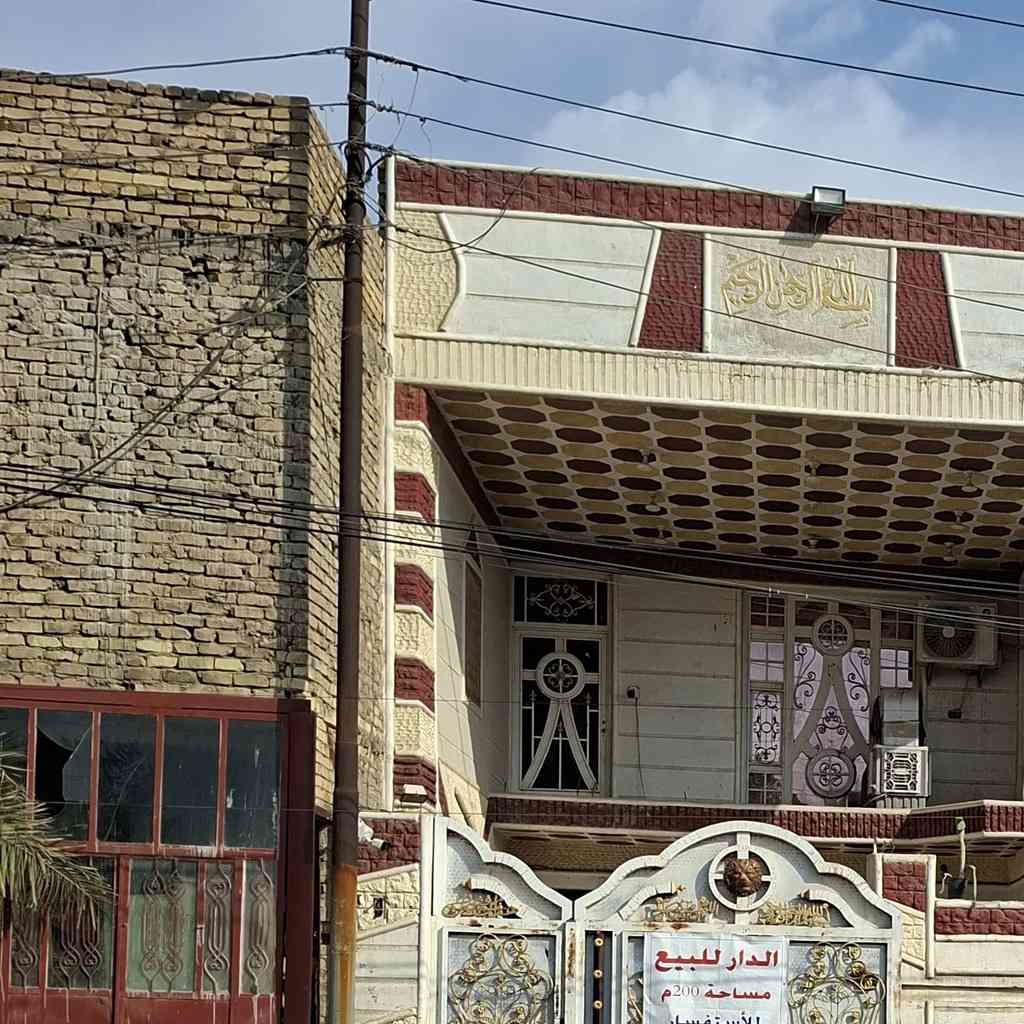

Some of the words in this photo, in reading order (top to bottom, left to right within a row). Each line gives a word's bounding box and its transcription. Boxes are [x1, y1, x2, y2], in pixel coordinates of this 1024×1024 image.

[655, 948, 720, 972] للبيع
[726, 948, 778, 971] الدار
[704, 984, 771, 1000] مساحة
